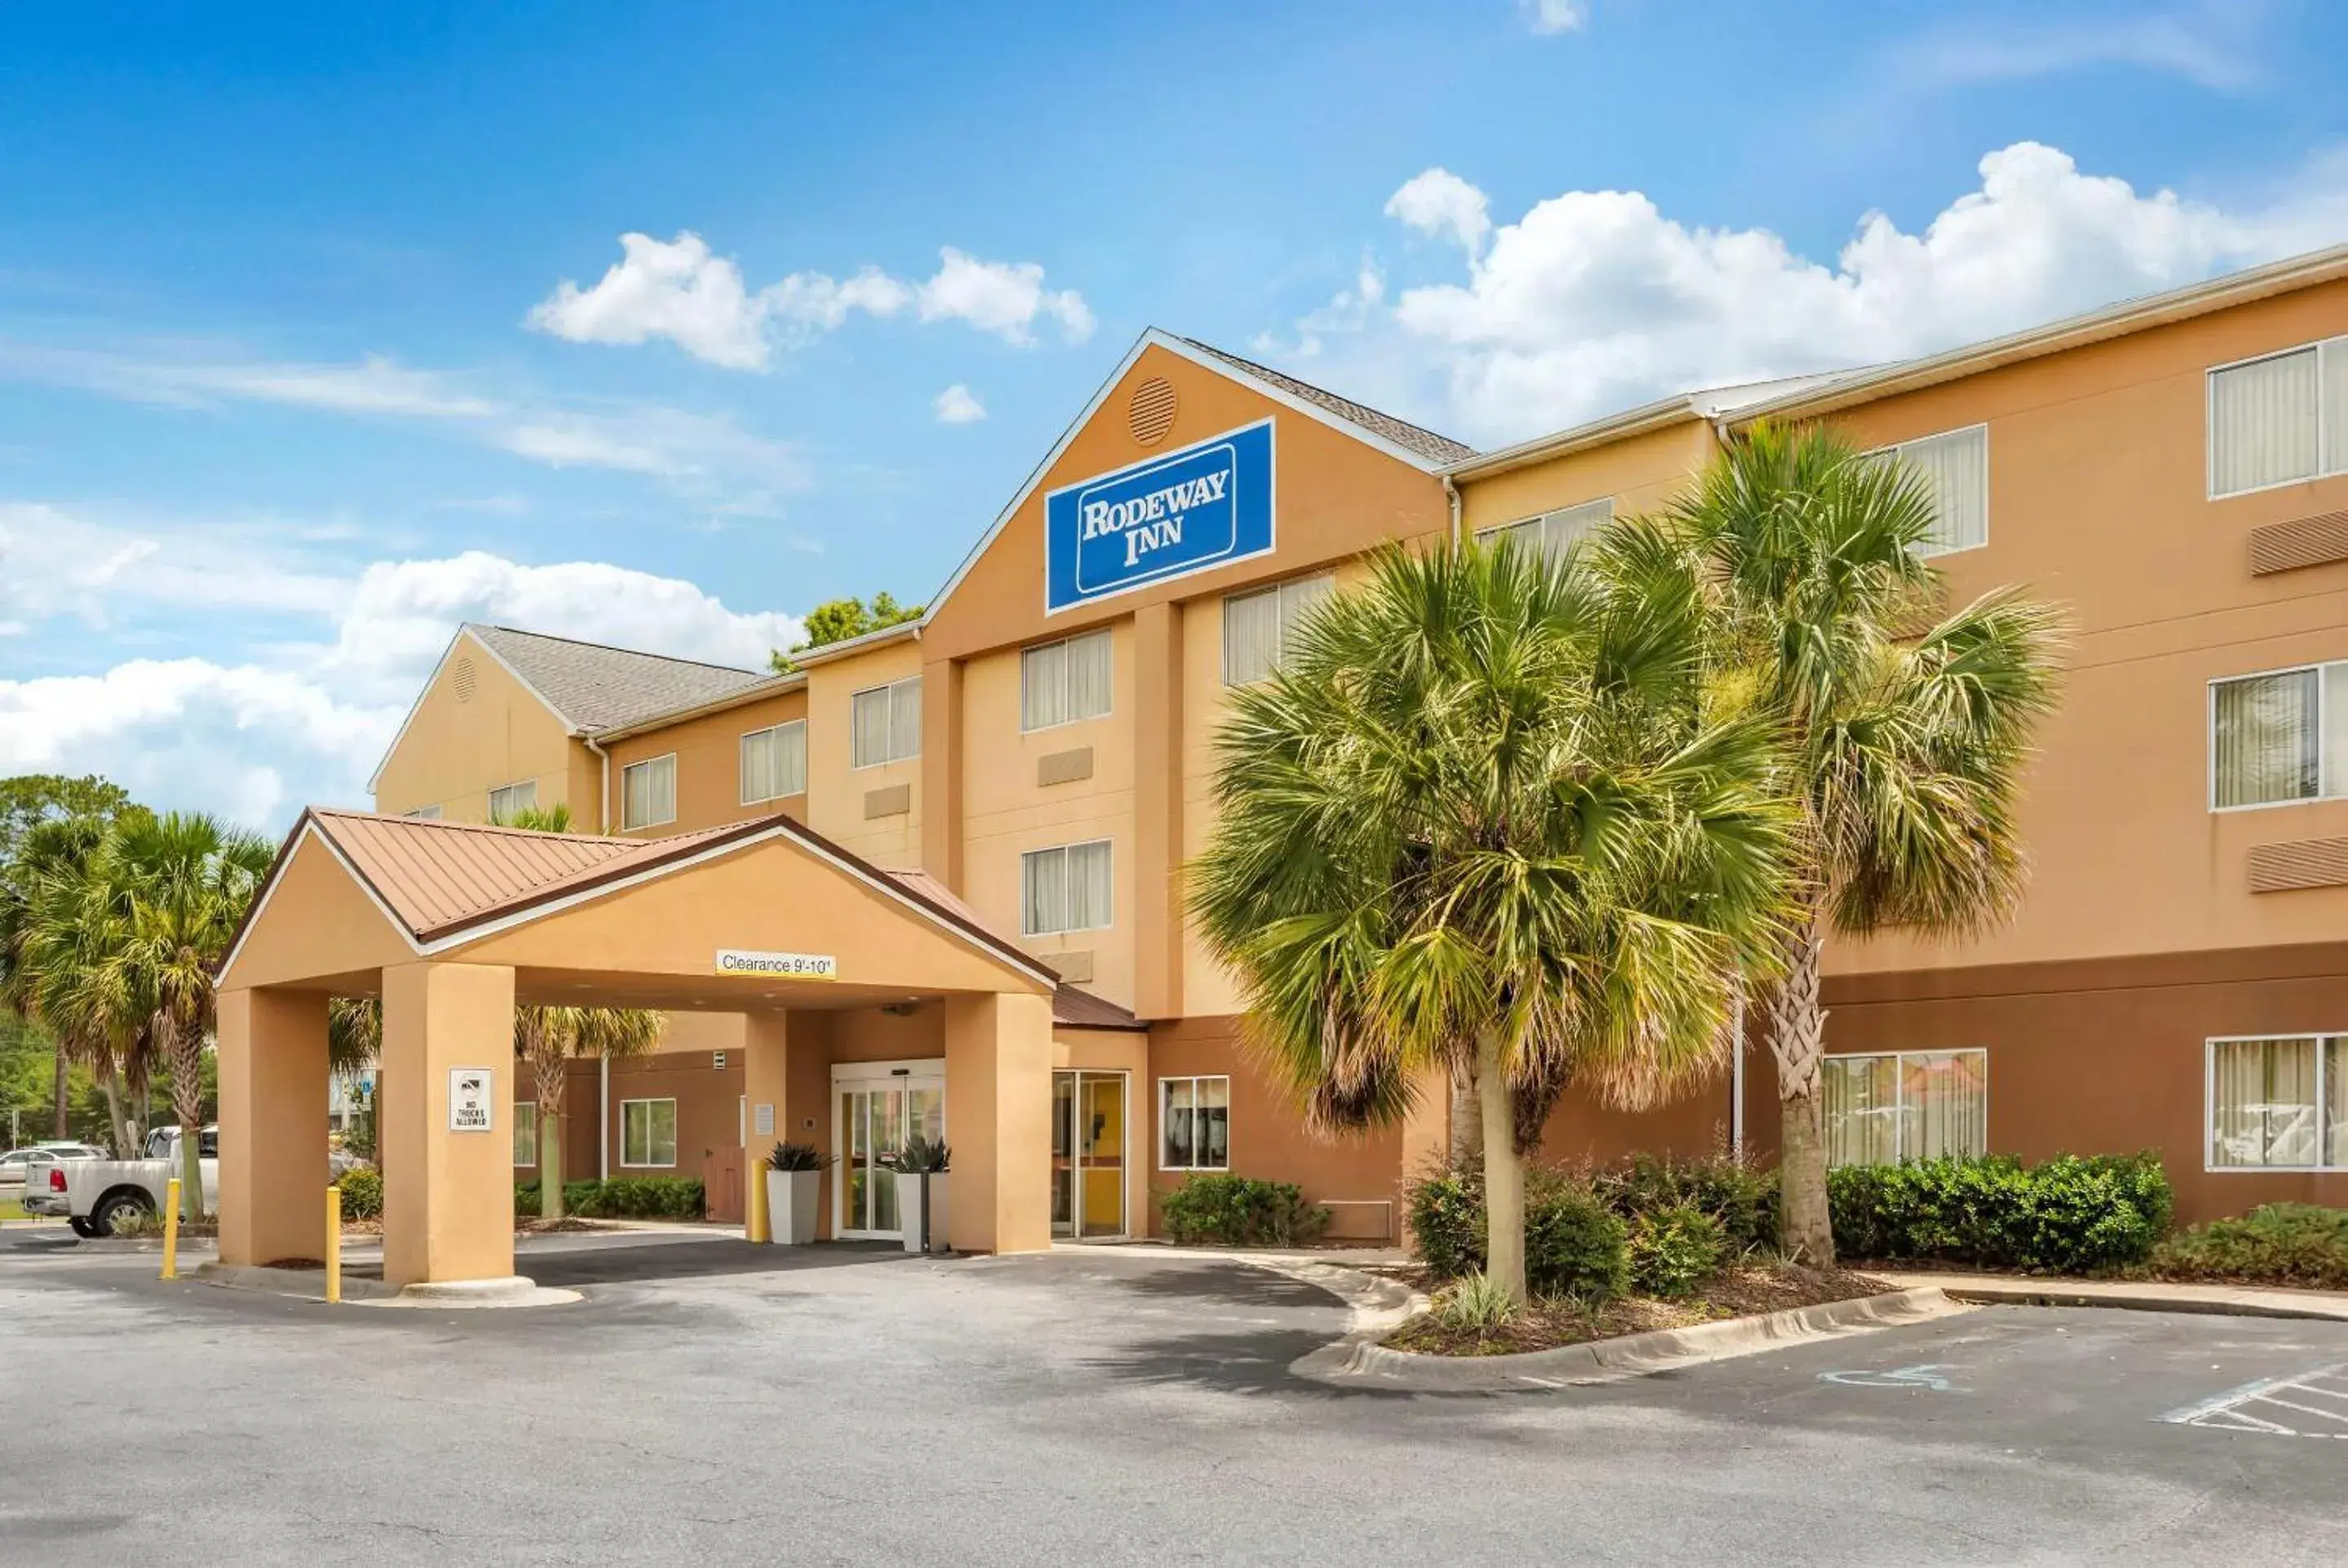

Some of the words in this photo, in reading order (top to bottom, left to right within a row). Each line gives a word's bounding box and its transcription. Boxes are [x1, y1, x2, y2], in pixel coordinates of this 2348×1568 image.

[1083, 470, 1230, 541] RODEWAY
[1124, 516, 1184, 567] INN
[723, 954, 790, 972] Clearance
